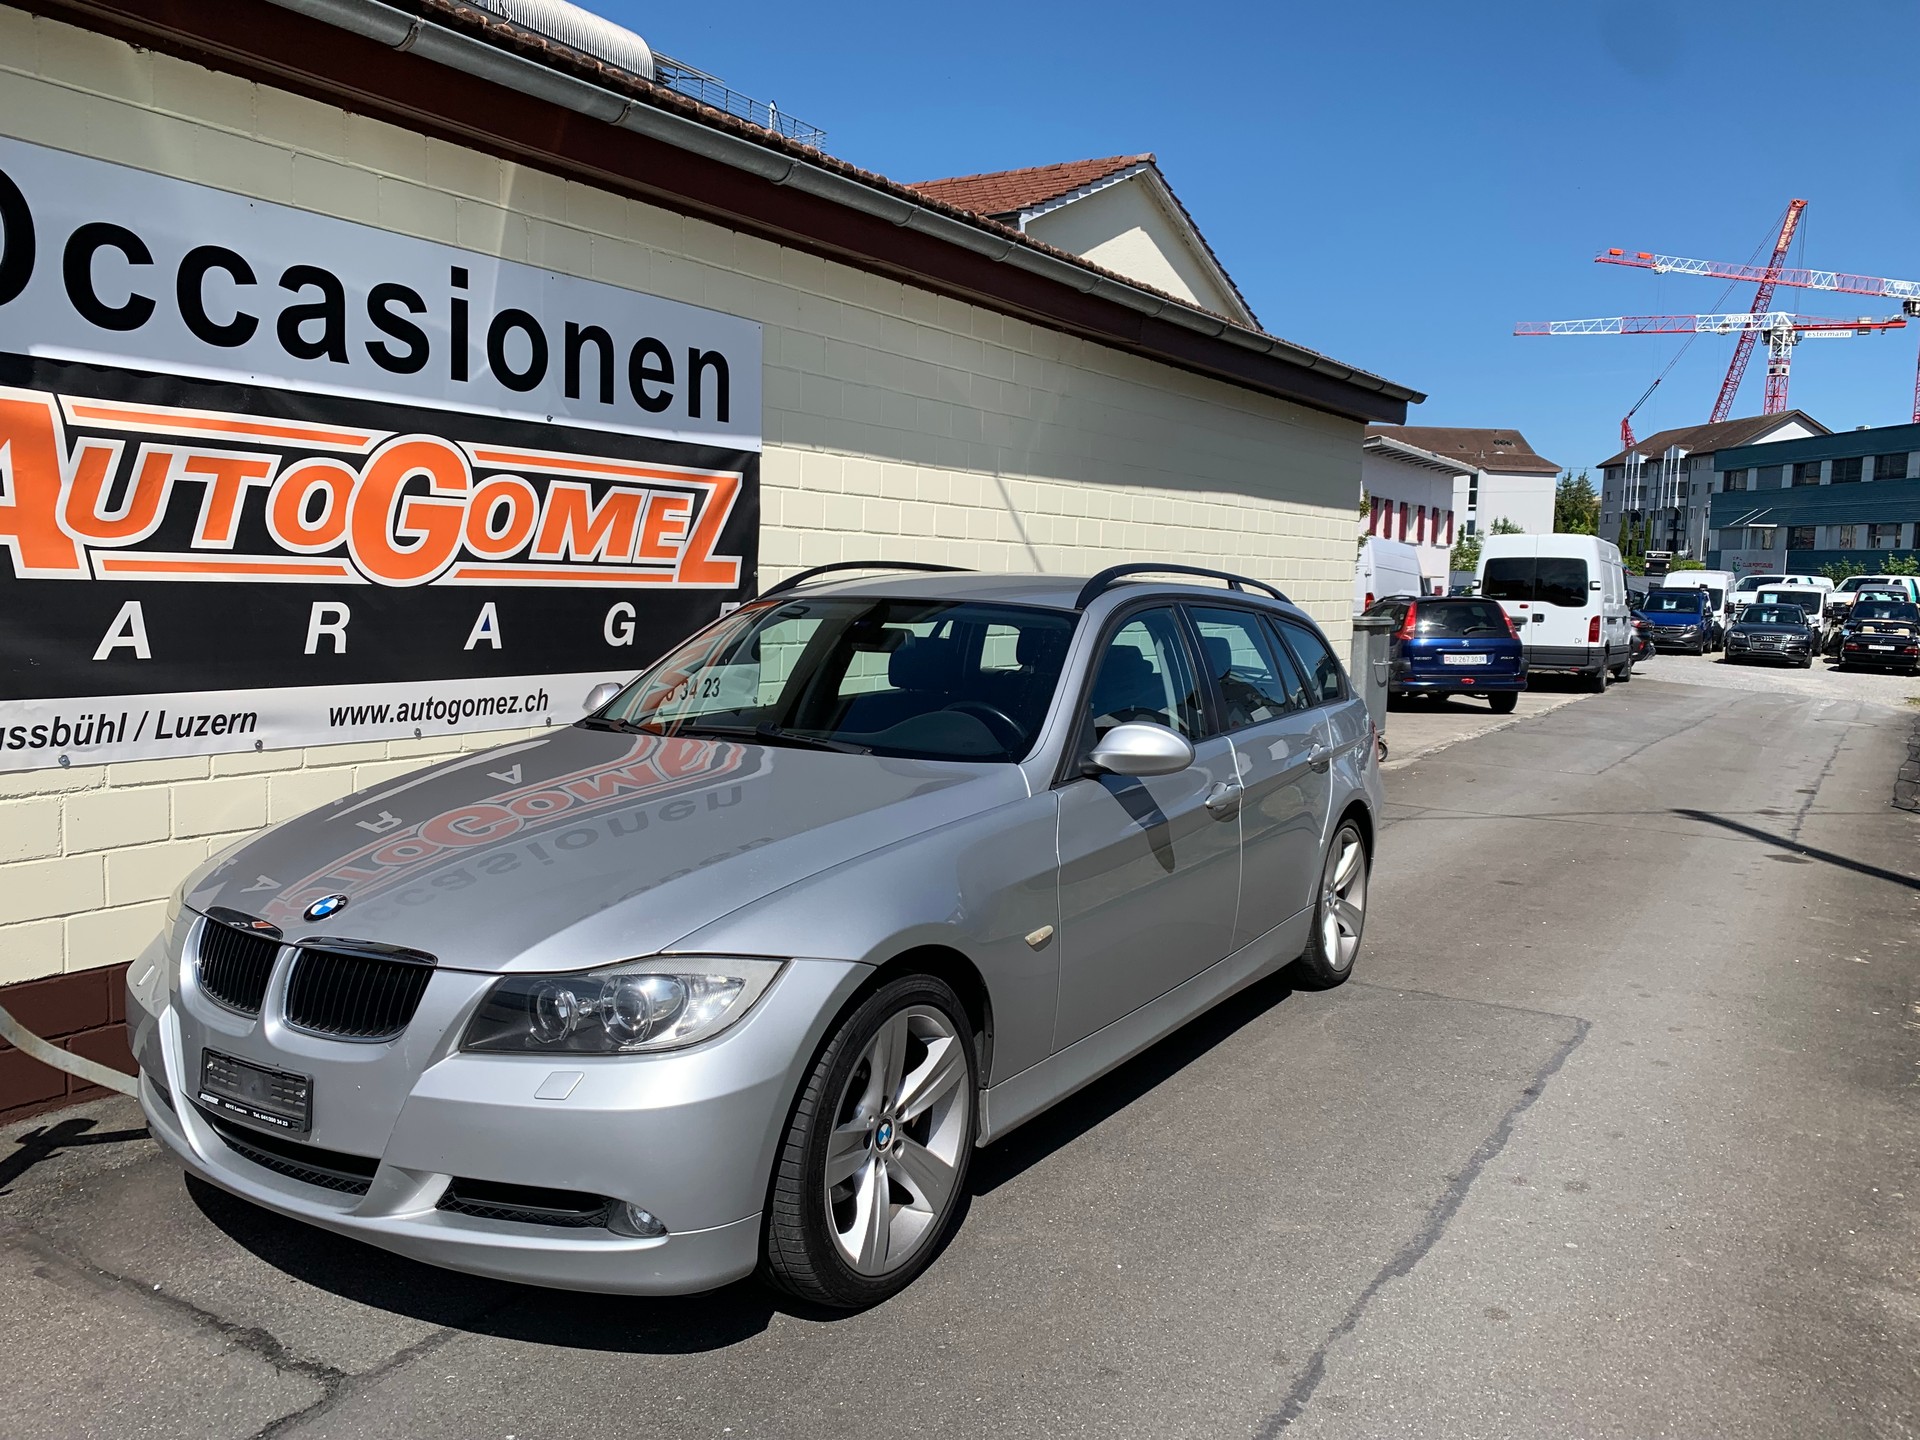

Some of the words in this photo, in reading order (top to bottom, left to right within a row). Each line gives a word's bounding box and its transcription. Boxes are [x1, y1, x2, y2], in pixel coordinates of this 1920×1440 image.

[0, 168, 730, 424] ccasionen
[329, 688, 549, 728] www.autogomez.ch
[702, 677, 721, 699] 23
[0, 711, 133, 751] ssbühl
[133, 711, 149, 741] /
[154, 711, 258, 740] Luzern
